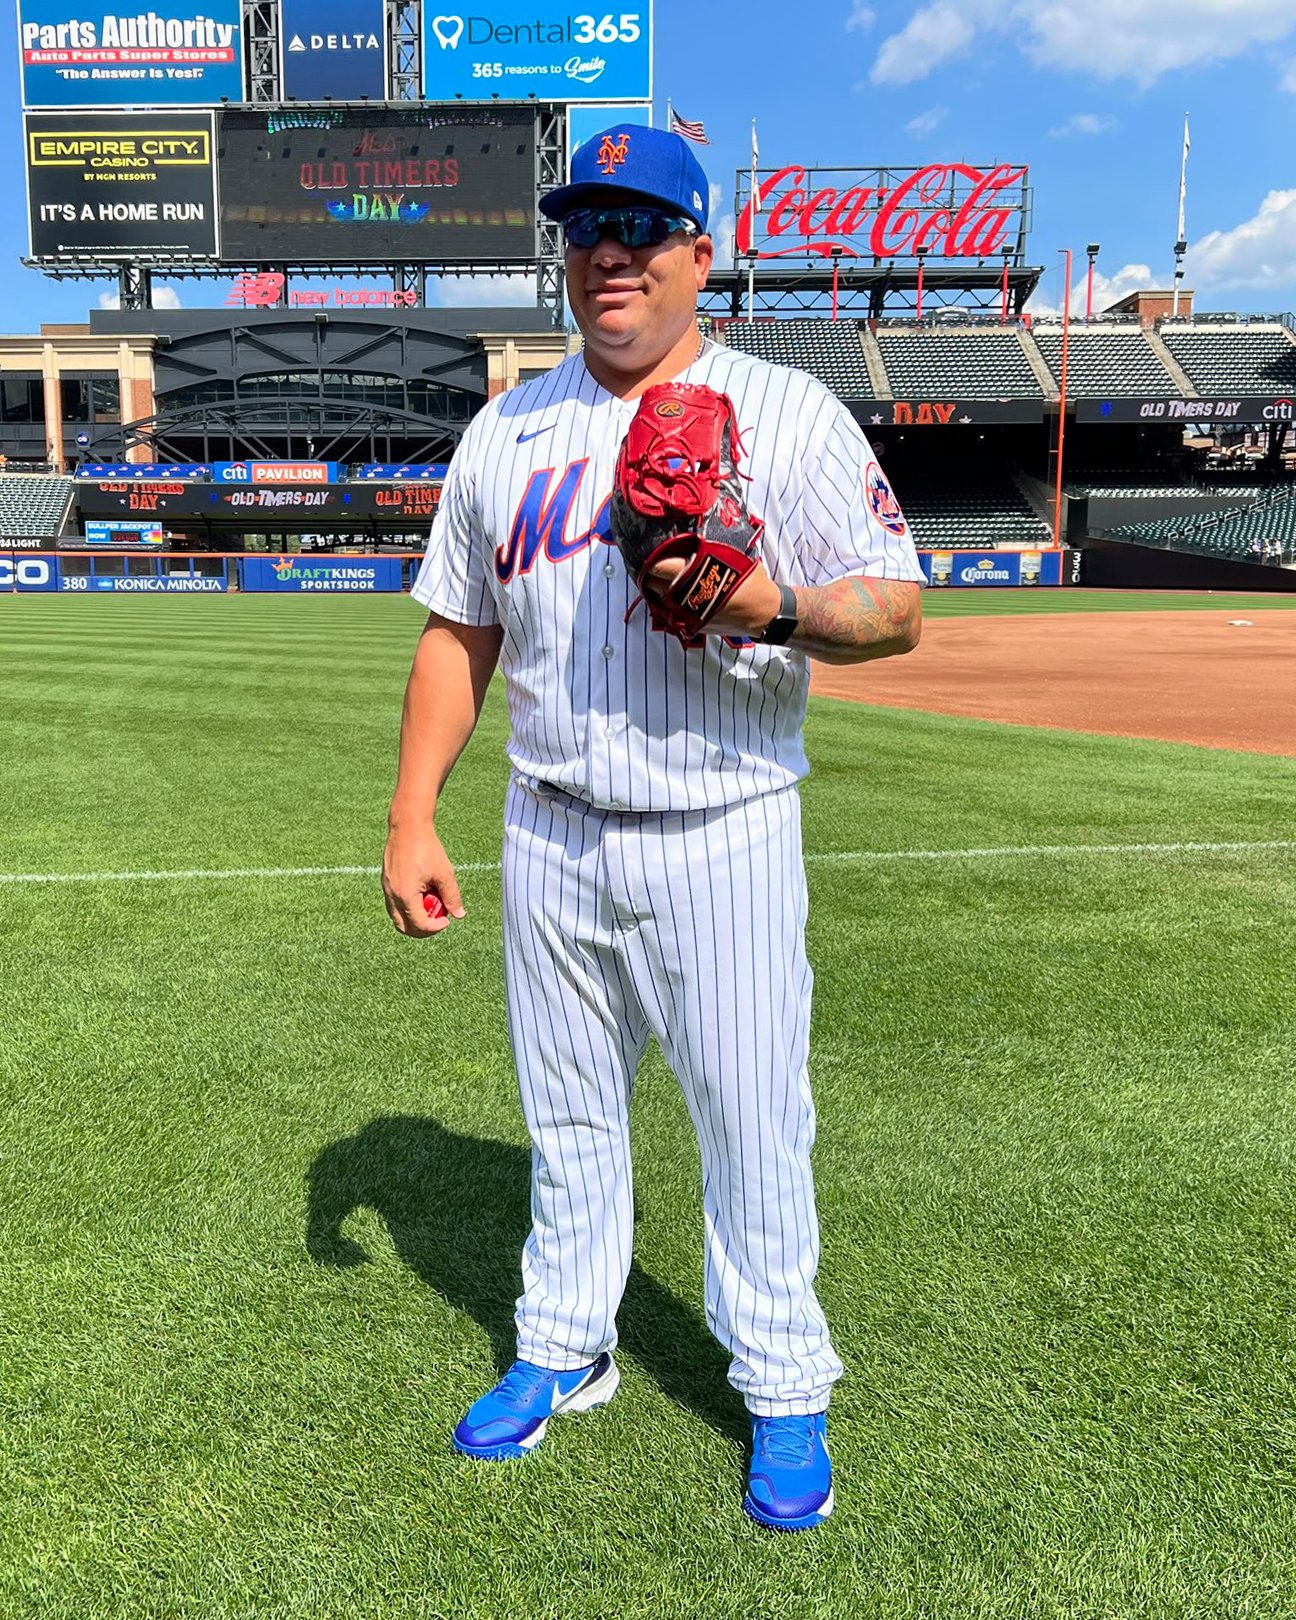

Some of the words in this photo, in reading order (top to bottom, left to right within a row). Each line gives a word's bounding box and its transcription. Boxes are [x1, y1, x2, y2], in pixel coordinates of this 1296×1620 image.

[22, 19, 97, 49] Parts
[101, 12, 233, 49] Authority
[467, 13, 641, 44] Dental365
[311, 34, 380, 49] DELTA
[31, 51, 68, 61] Auto
[72, 50, 116, 60] Parts
[119, 50, 169, 60] Super
[173, 49, 228, 59] Stores
[91, 68, 147, 79] Answer
[149, 68, 163, 79] Is
[471, 63, 503, 78] 365
[504, 65, 548, 75] reasons
[550, 63, 562, 74] to
[564, 56, 606, 83] Smile
[40, 142, 136, 155] EMPIRE
[90, 157, 149, 167] CASINO
[84, 173, 94, 181] BY
[96, 173, 116, 181] MGM
[118, 173, 157, 181] RESORTS
[300, 161, 348, 189] OLD
[354, 158, 460, 188] TIMERS
[40, 204, 77, 222] IT'S
[80, 204, 95, 221] A
[99, 203, 158, 221] HOME
[163, 203, 204, 220] RUN
[352, 193, 405, 221] DAY
[290, 291, 329, 305] new
[334, 287, 416, 305] balance
[893, 402, 956, 424] DAY
[1140, 402, 1164, 418] OLD
[1168, 400, 1213, 418] TIMERS
[1215, 401, 1241, 416] DAY
[1263, 402, 1293, 419] citi
[222, 465, 247, 480] citi
[256, 468, 322, 480] PAVILION
[129, 493, 158, 510] DAY
[231, 492, 254, 506] OLD
[258, 490, 301, 506] TIMERS
[304, 491, 329, 506] DAY
[375, 491, 402, 506] OLD
[12, 539, 41, 548] LIGHT
[276, 567, 376, 581] DRAFTKINGS
[960, 567, 1010, 583] Corona
[62, 577, 87, 590] 380
[114, 579, 163, 590] KONICA
[166, 580, 222, 590] MINOLTA
[301, 581, 375, 589] SPORTSBOOK
